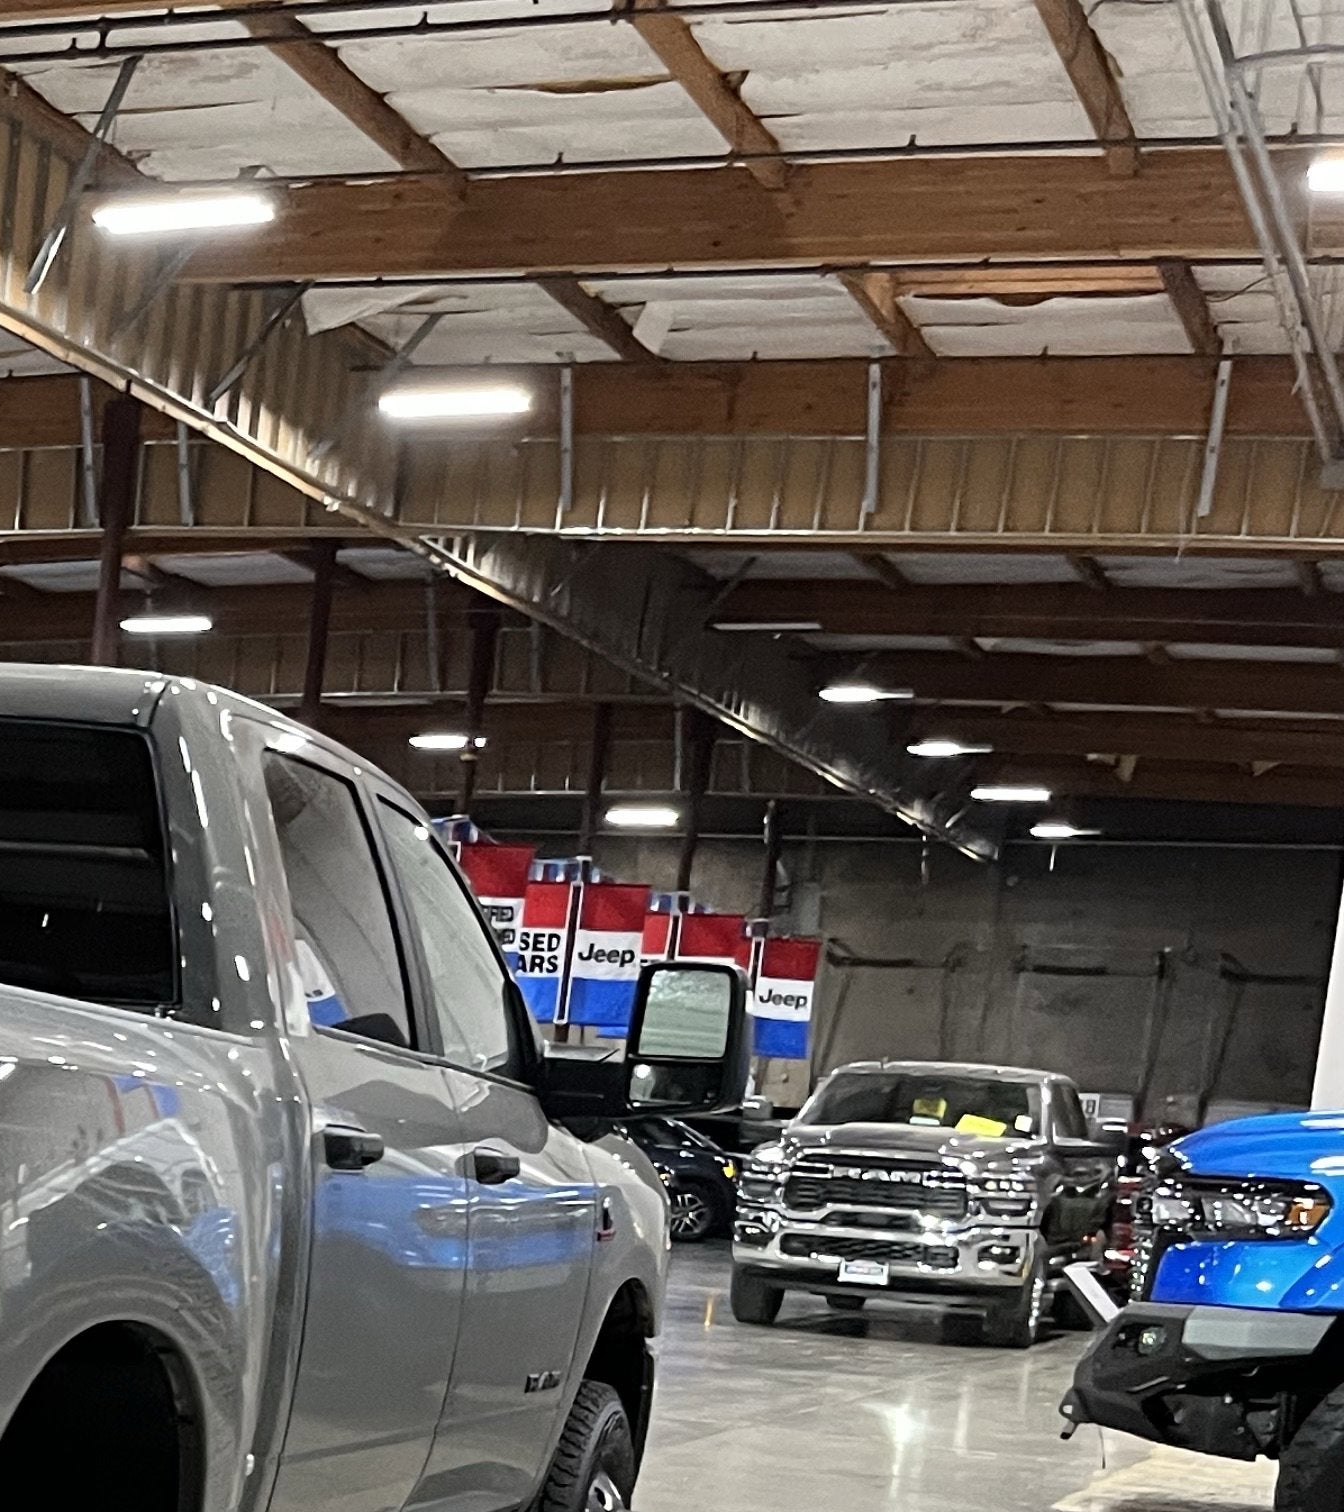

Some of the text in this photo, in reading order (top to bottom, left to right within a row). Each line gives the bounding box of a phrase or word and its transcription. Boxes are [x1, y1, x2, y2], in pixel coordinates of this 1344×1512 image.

[518, 932, 562, 953] SED
[516, 954, 559, 974] ARS
[577, 943, 636, 969] Jeep
[758, 988, 808, 1011] Jeep
